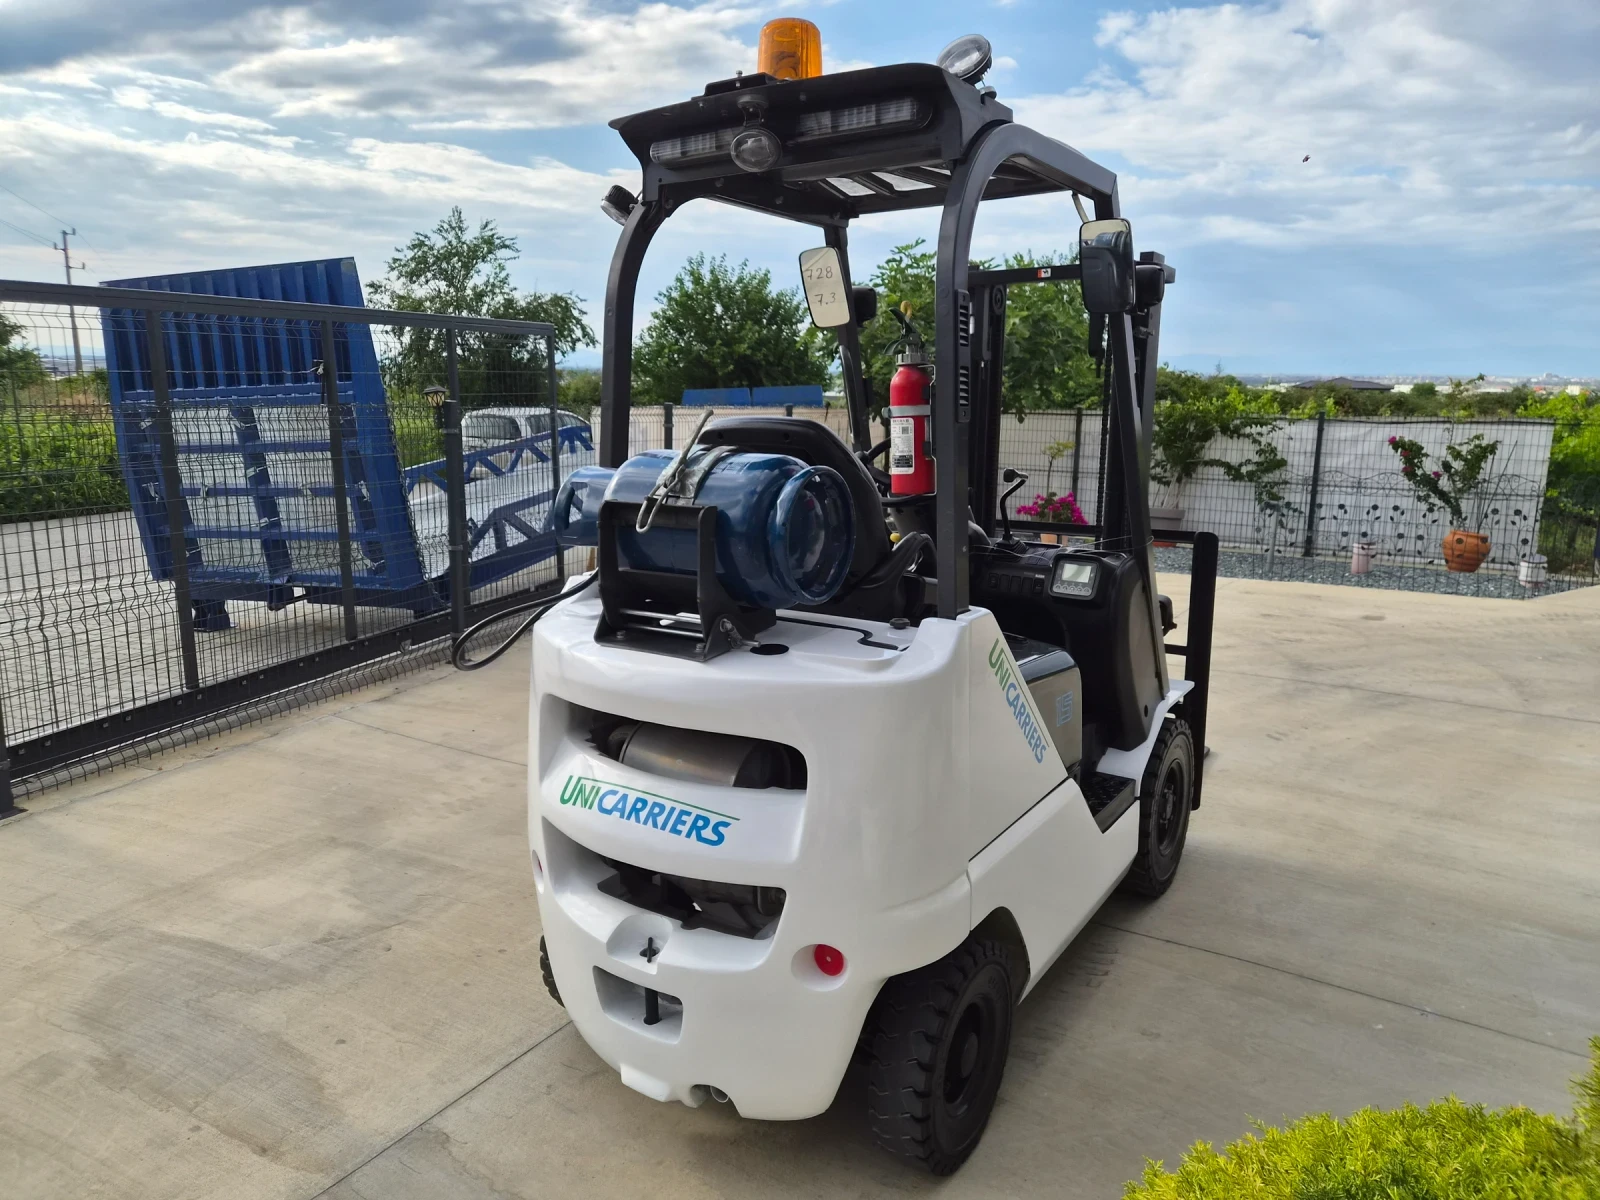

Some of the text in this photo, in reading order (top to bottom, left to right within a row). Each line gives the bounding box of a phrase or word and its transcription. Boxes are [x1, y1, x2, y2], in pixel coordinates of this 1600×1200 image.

[803, 266, 833, 280] 728
[988, 638, 1047, 764] UNICARRIERS
[1056, 691, 1073, 727] 15
[560, 775, 733, 847] UNICARRIERS
